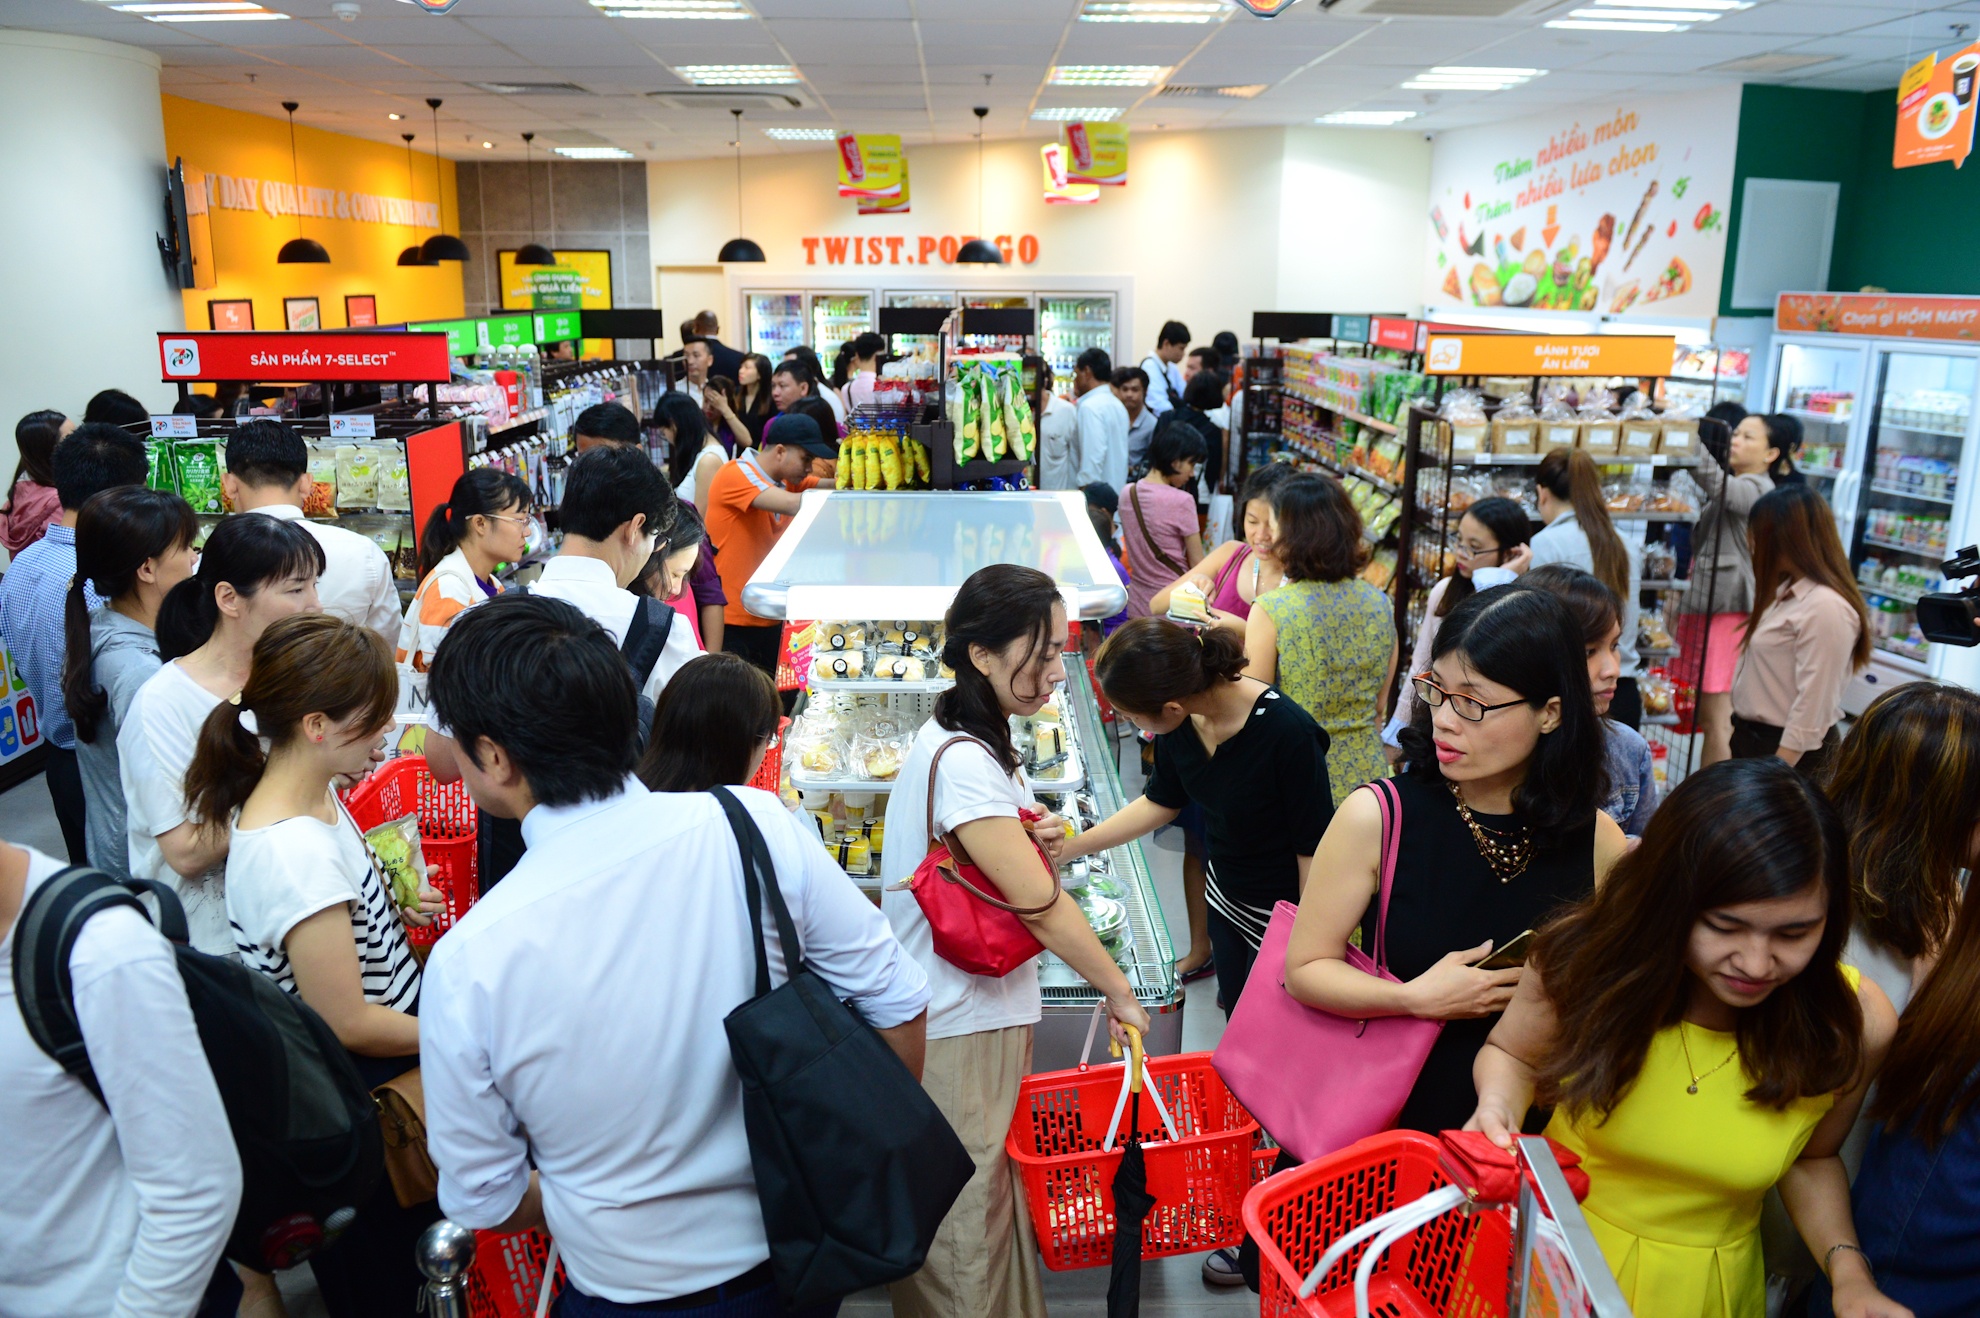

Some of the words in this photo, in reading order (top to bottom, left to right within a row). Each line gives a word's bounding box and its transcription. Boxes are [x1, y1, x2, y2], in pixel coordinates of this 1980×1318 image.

[1536, 122, 1590, 168] nhiều
[1594, 107, 1640, 145] món
[220, 175, 259, 211] DAY
[261, 179, 336, 219] QUALITY
[336, 189, 351, 220] &
[351, 191, 440, 228] CONVENIENCE
[1515, 168, 1566, 209] nhiều
[1608, 141, 1660, 178] chọn
[1935, 308, 1978, 324] NAY?
[250, 351, 278, 366] SẢN
[282, 349, 321, 366] PHẨM
